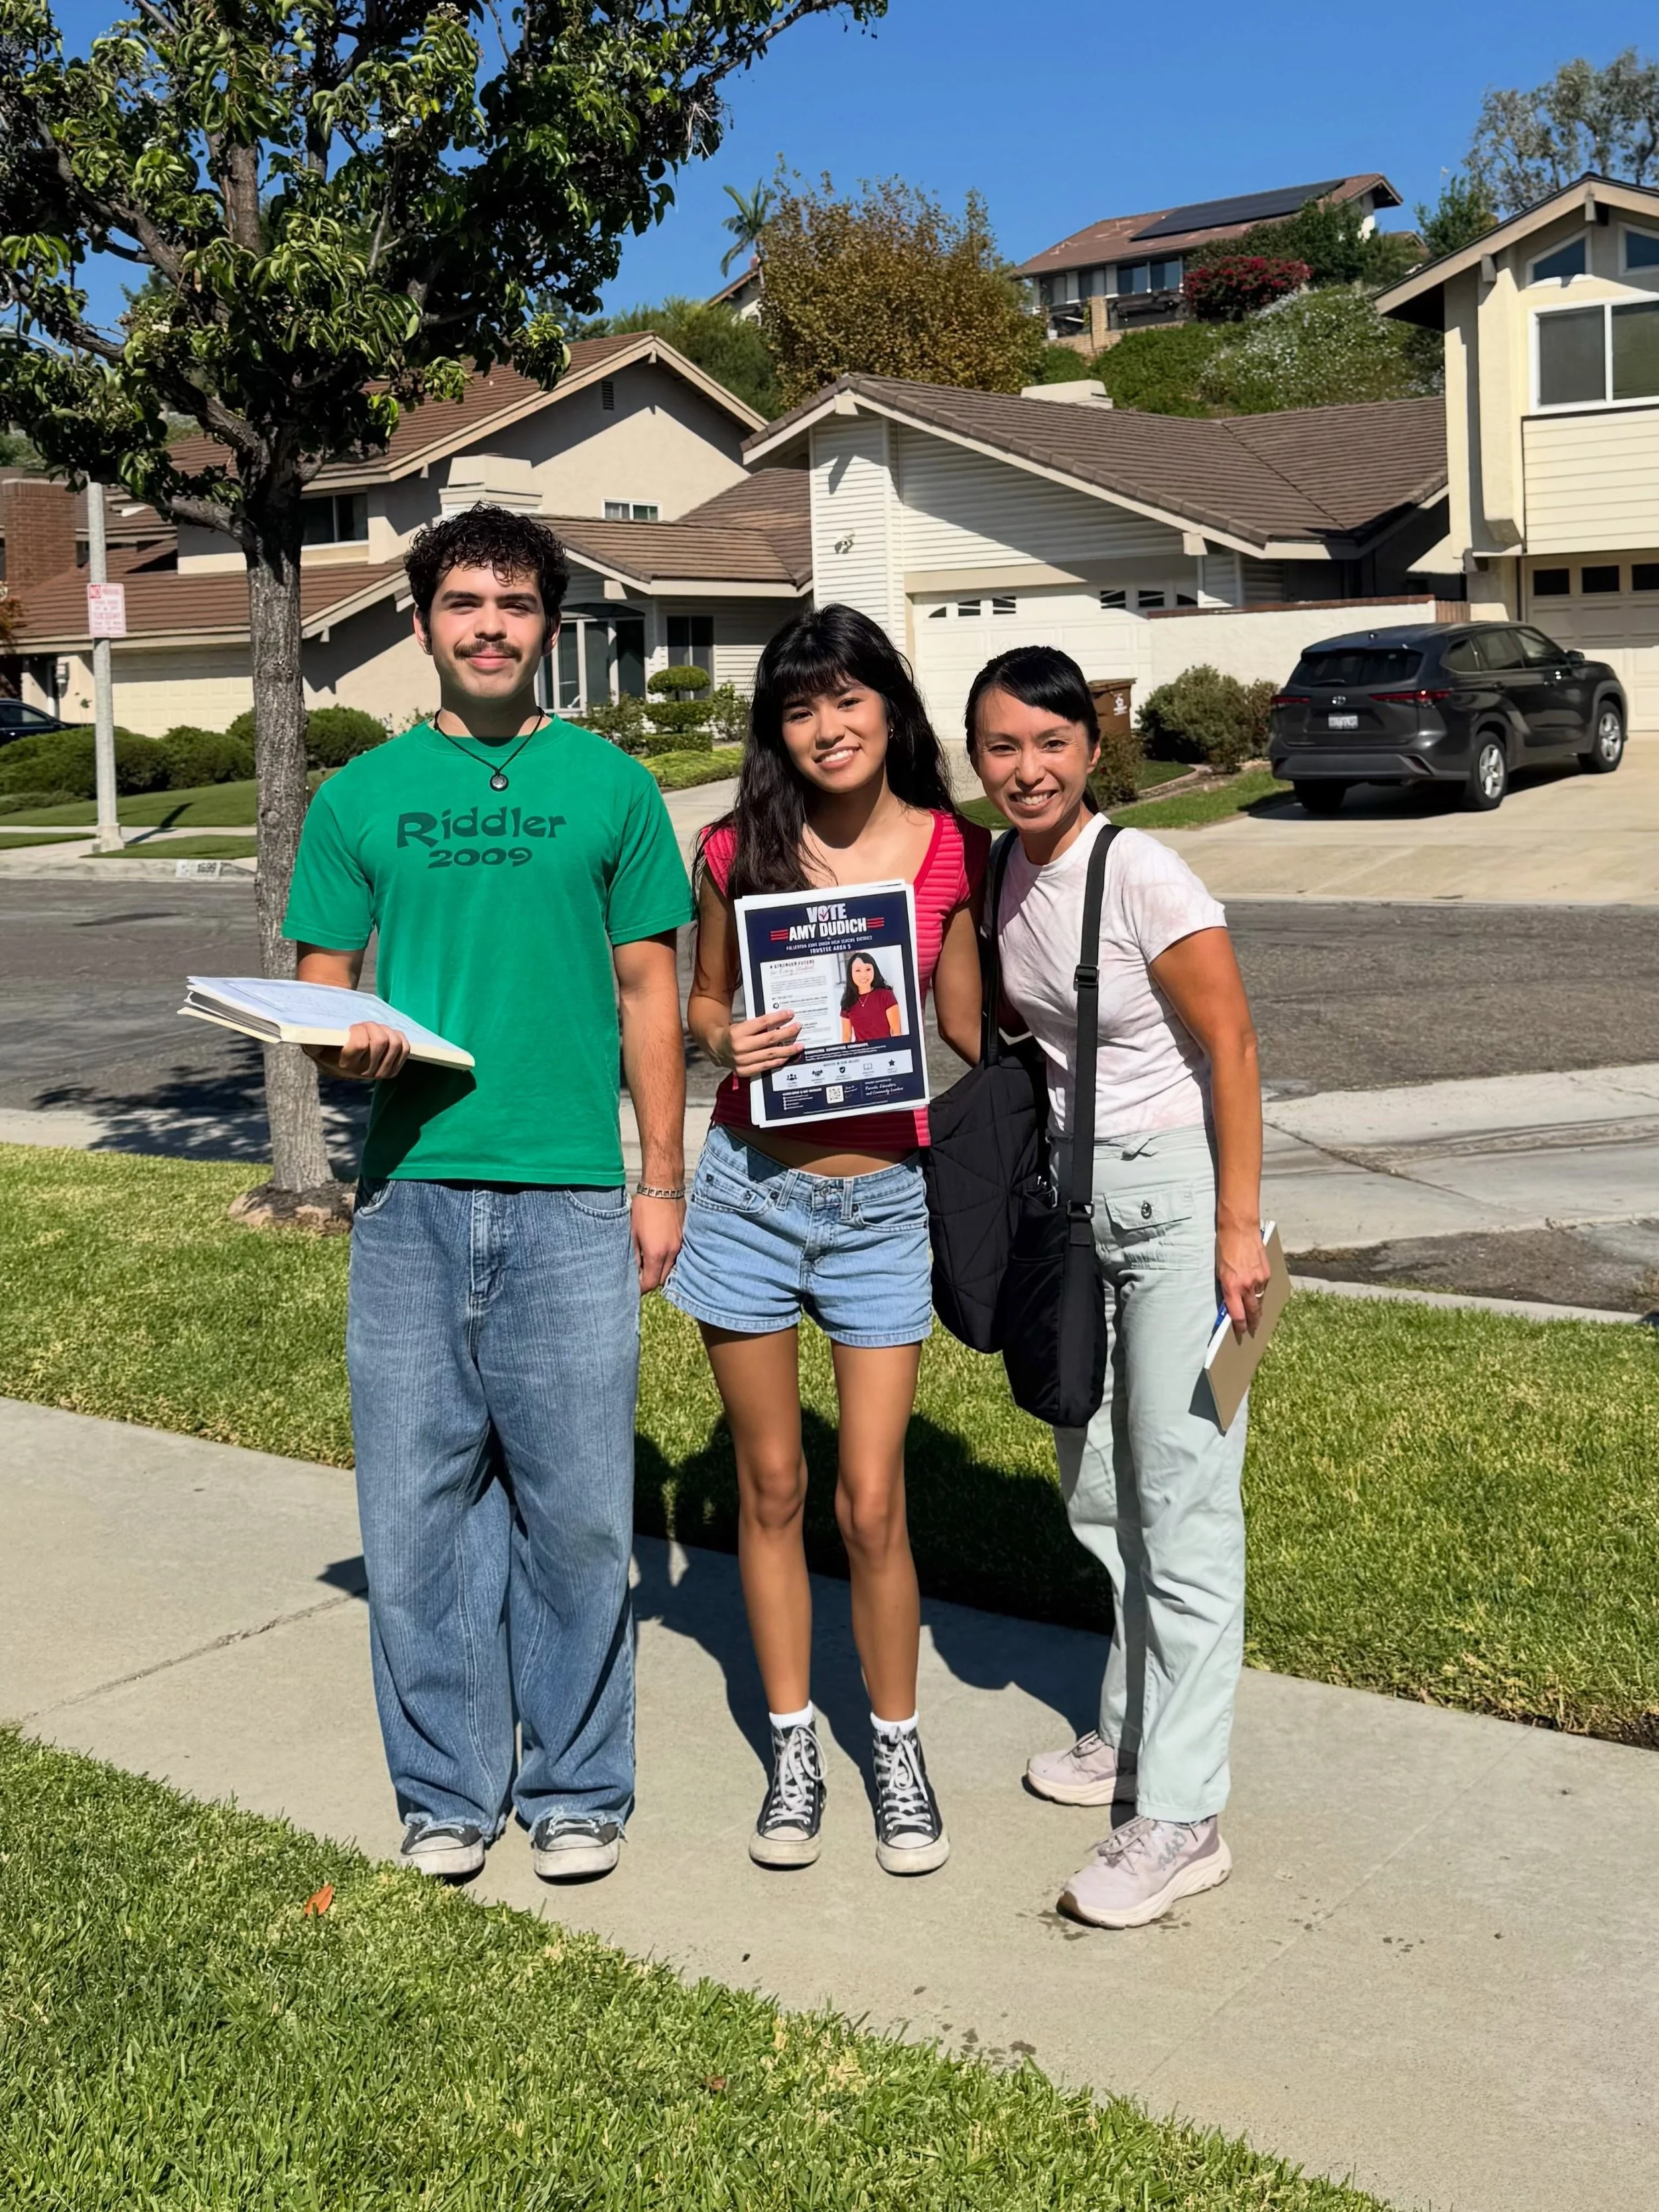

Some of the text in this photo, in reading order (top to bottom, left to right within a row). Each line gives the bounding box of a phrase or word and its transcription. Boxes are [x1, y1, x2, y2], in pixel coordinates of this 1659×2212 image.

[397, 806, 567, 849] Riddler
[427, 846, 533, 869] 2009
[806, 903, 847, 923] VOTE
[789, 917, 867, 941] AMY DUDICH
